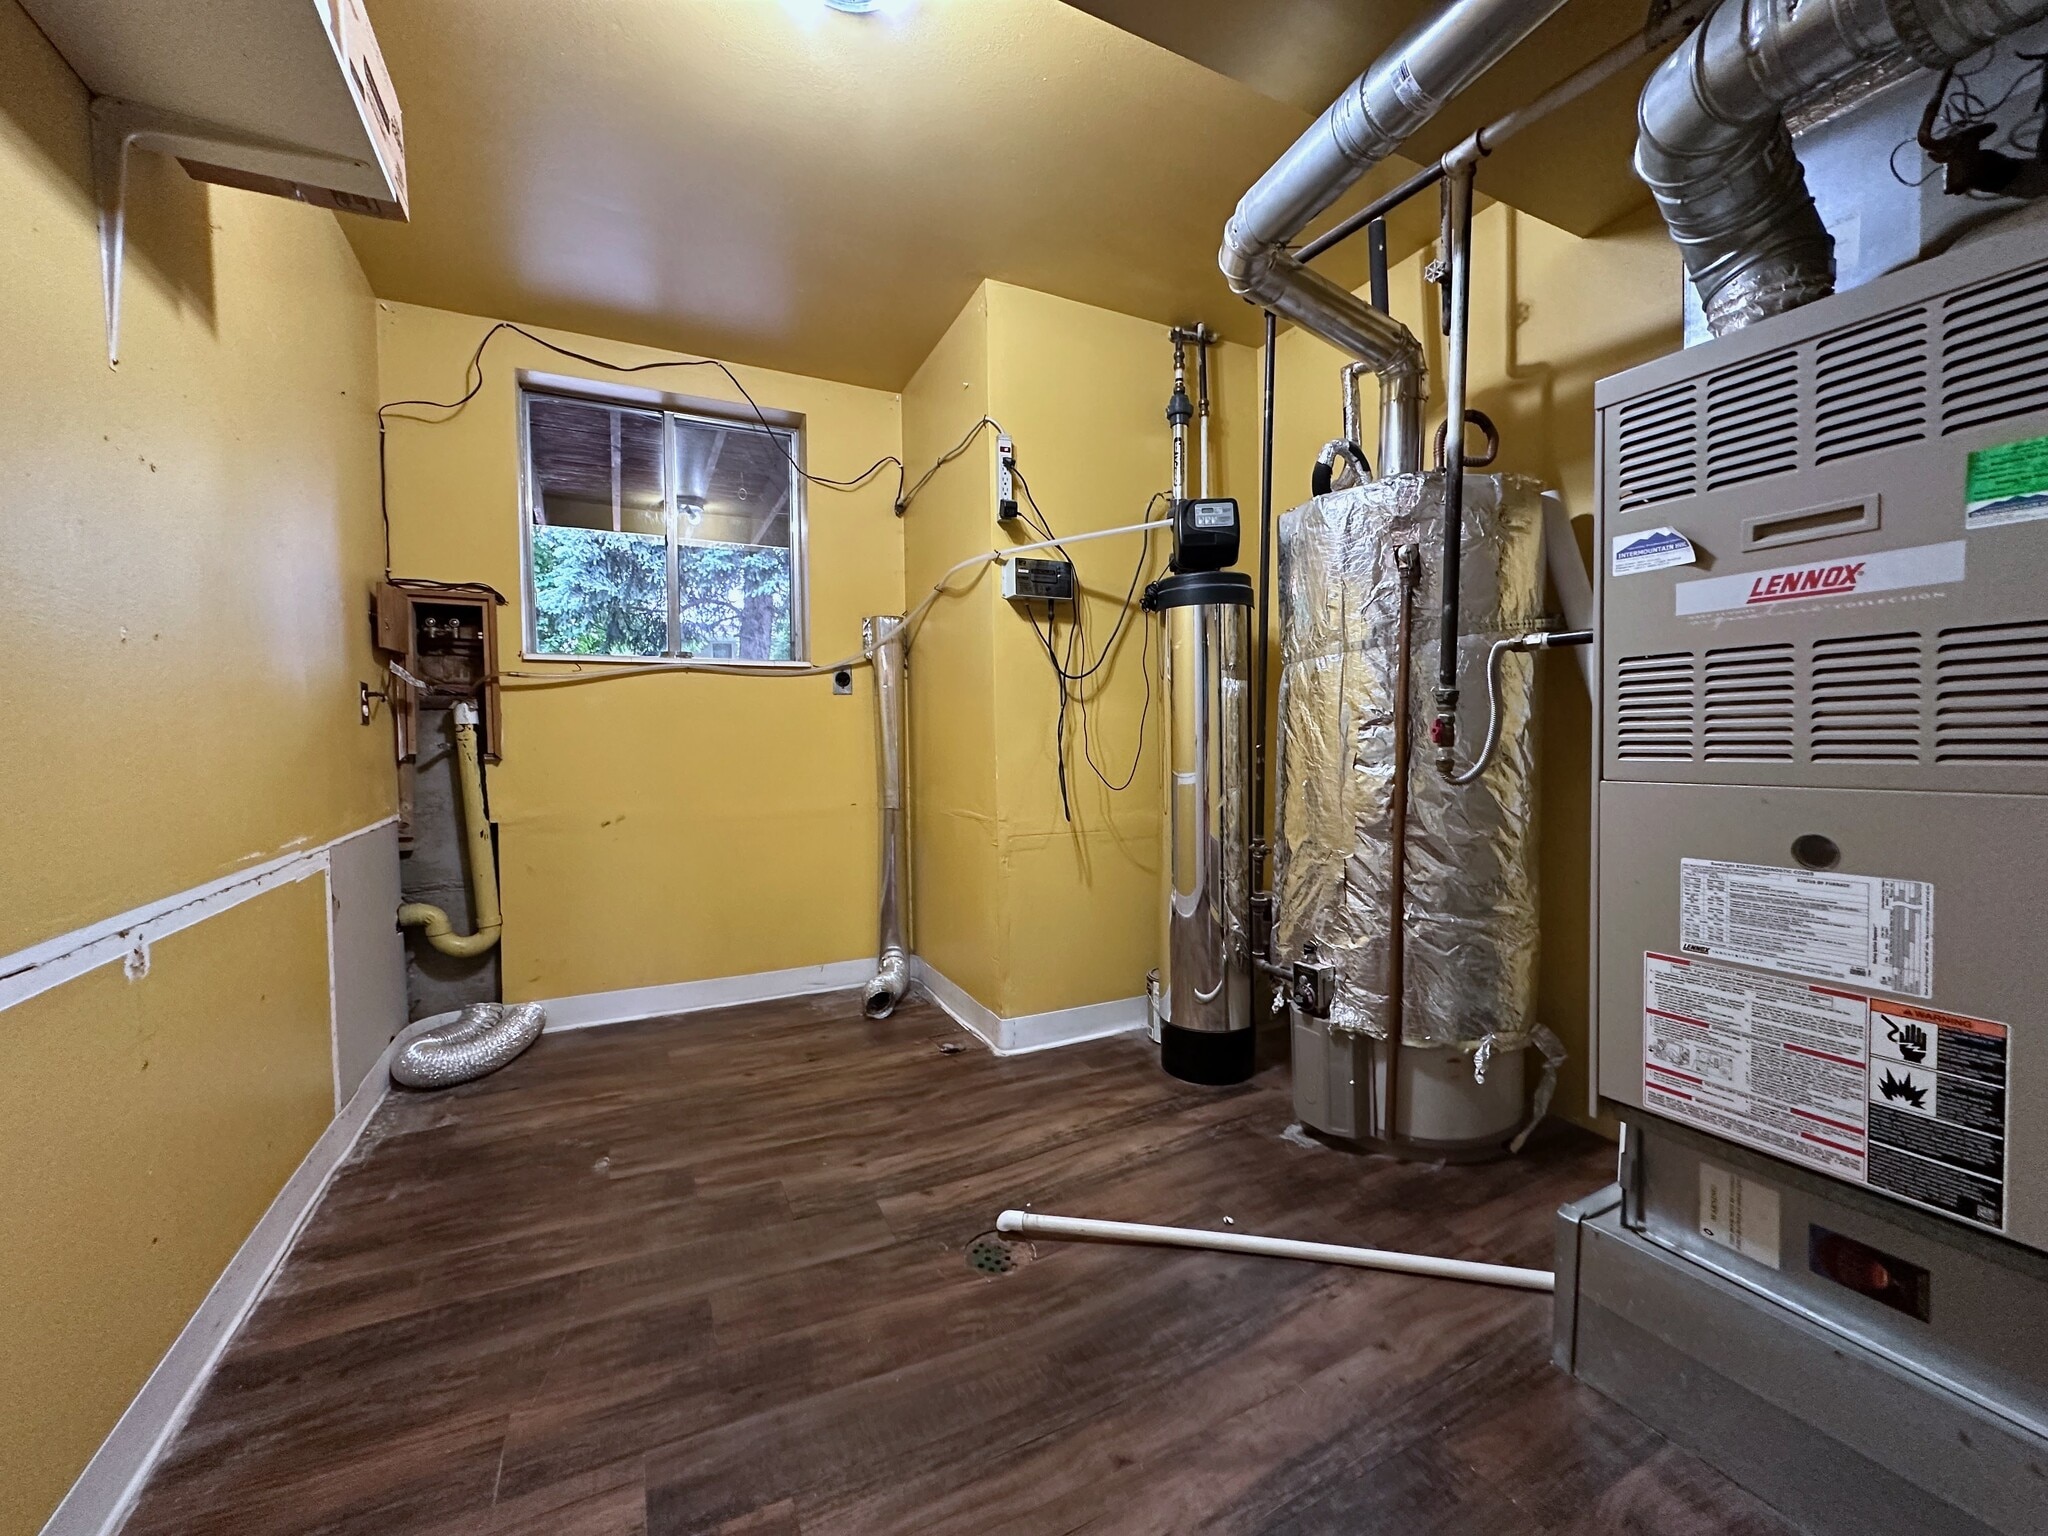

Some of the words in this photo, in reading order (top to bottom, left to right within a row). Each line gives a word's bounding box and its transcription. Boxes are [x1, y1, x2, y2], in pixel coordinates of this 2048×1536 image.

[1618, 544, 1674, 559] INTERMOUNTAIN
[1750, 562, 1866, 597] LENNOX
[1683, 943, 1710, 954] LENNOX
[1914, 1010, 1972, 1029] WARNING
